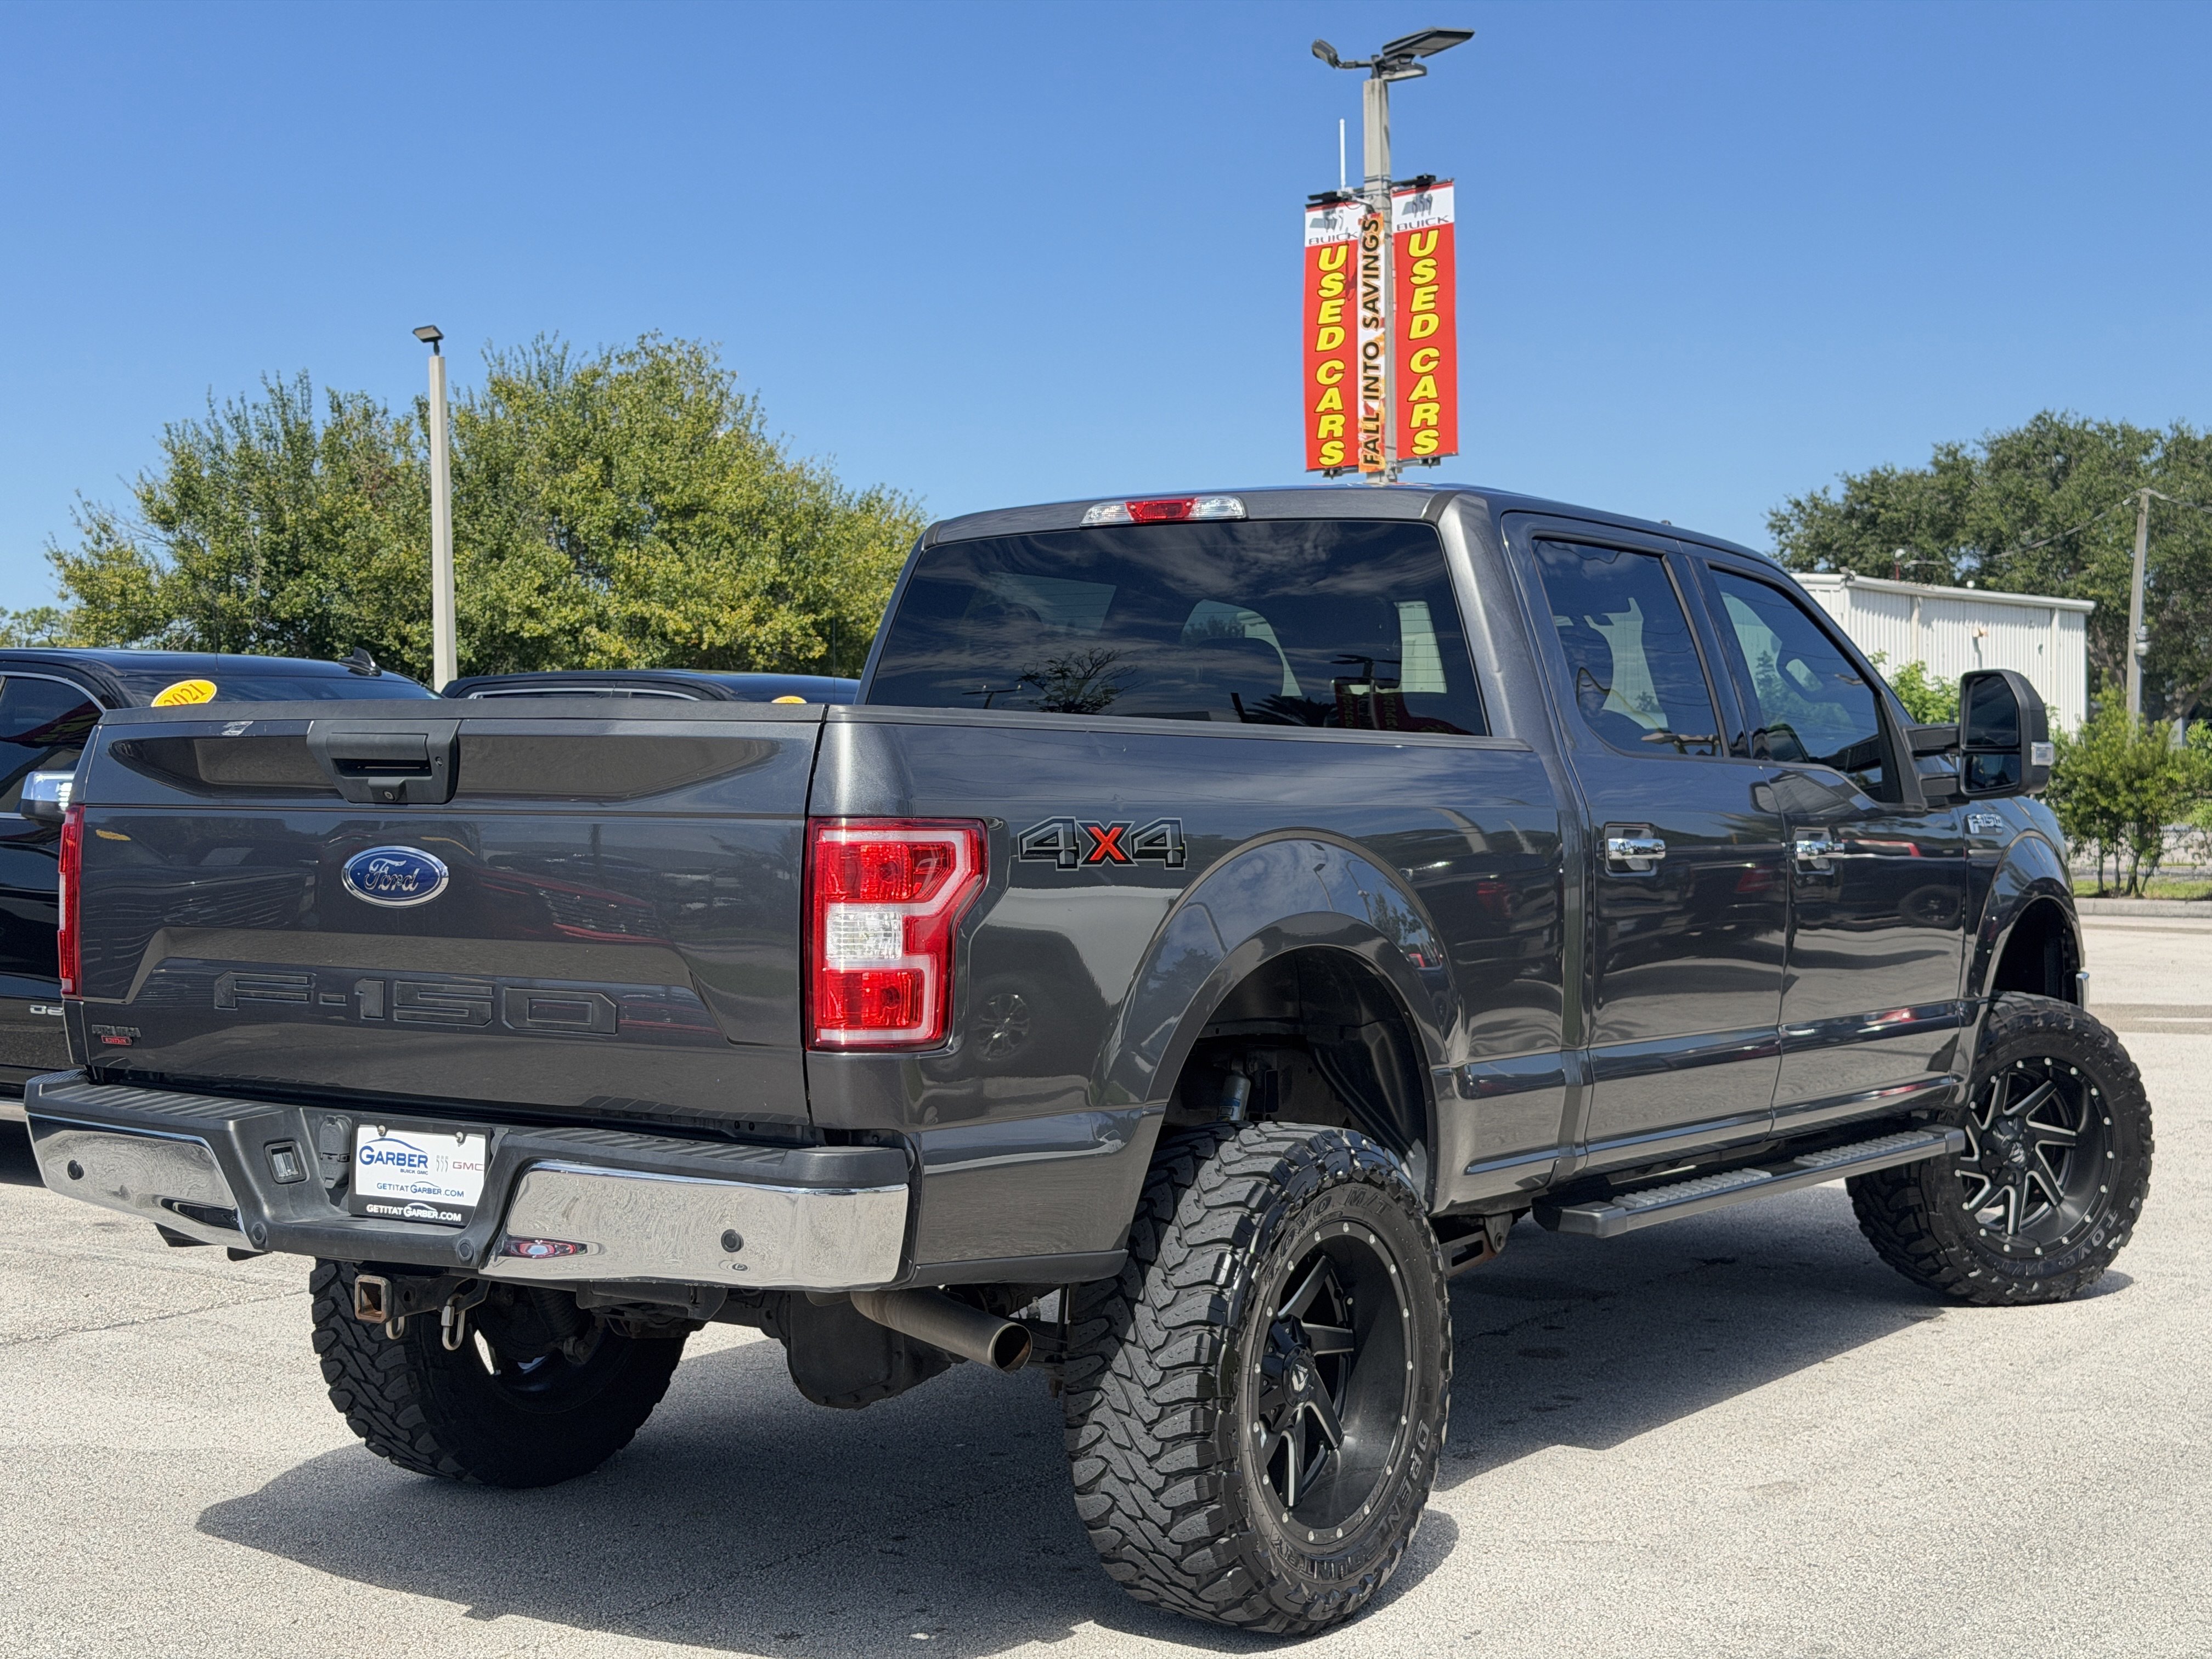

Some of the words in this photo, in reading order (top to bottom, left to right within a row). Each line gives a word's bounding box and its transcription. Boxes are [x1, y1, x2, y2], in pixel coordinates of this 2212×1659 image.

[1308, 230, 1359, 245] BUICK
[1396, 215, 1449, 232] BUICK
[1314, 244, 1350, 352] USED
[1362, 218, 1380, 330] SAVINGS
[1408, 228, 1441, 341] USED
[1363, 341, 1381, 401] INTO
[1313, 358, 1346, 466] CARS
[1407, 347, 1441, 456] CARS
[1363, 412, 1380, 466] FALL
[364, 857, 421, 891] Ford
[214, 970, 618, 1035] F-150
[359, 1145, 428, 1169] GARBER
[452, 1161, 485, 1171] GMC
[366, 1203, 461, 1222] GETITATGARBER.COM
[376, 1182, 464, 1198] GETITATGARBER.COM
